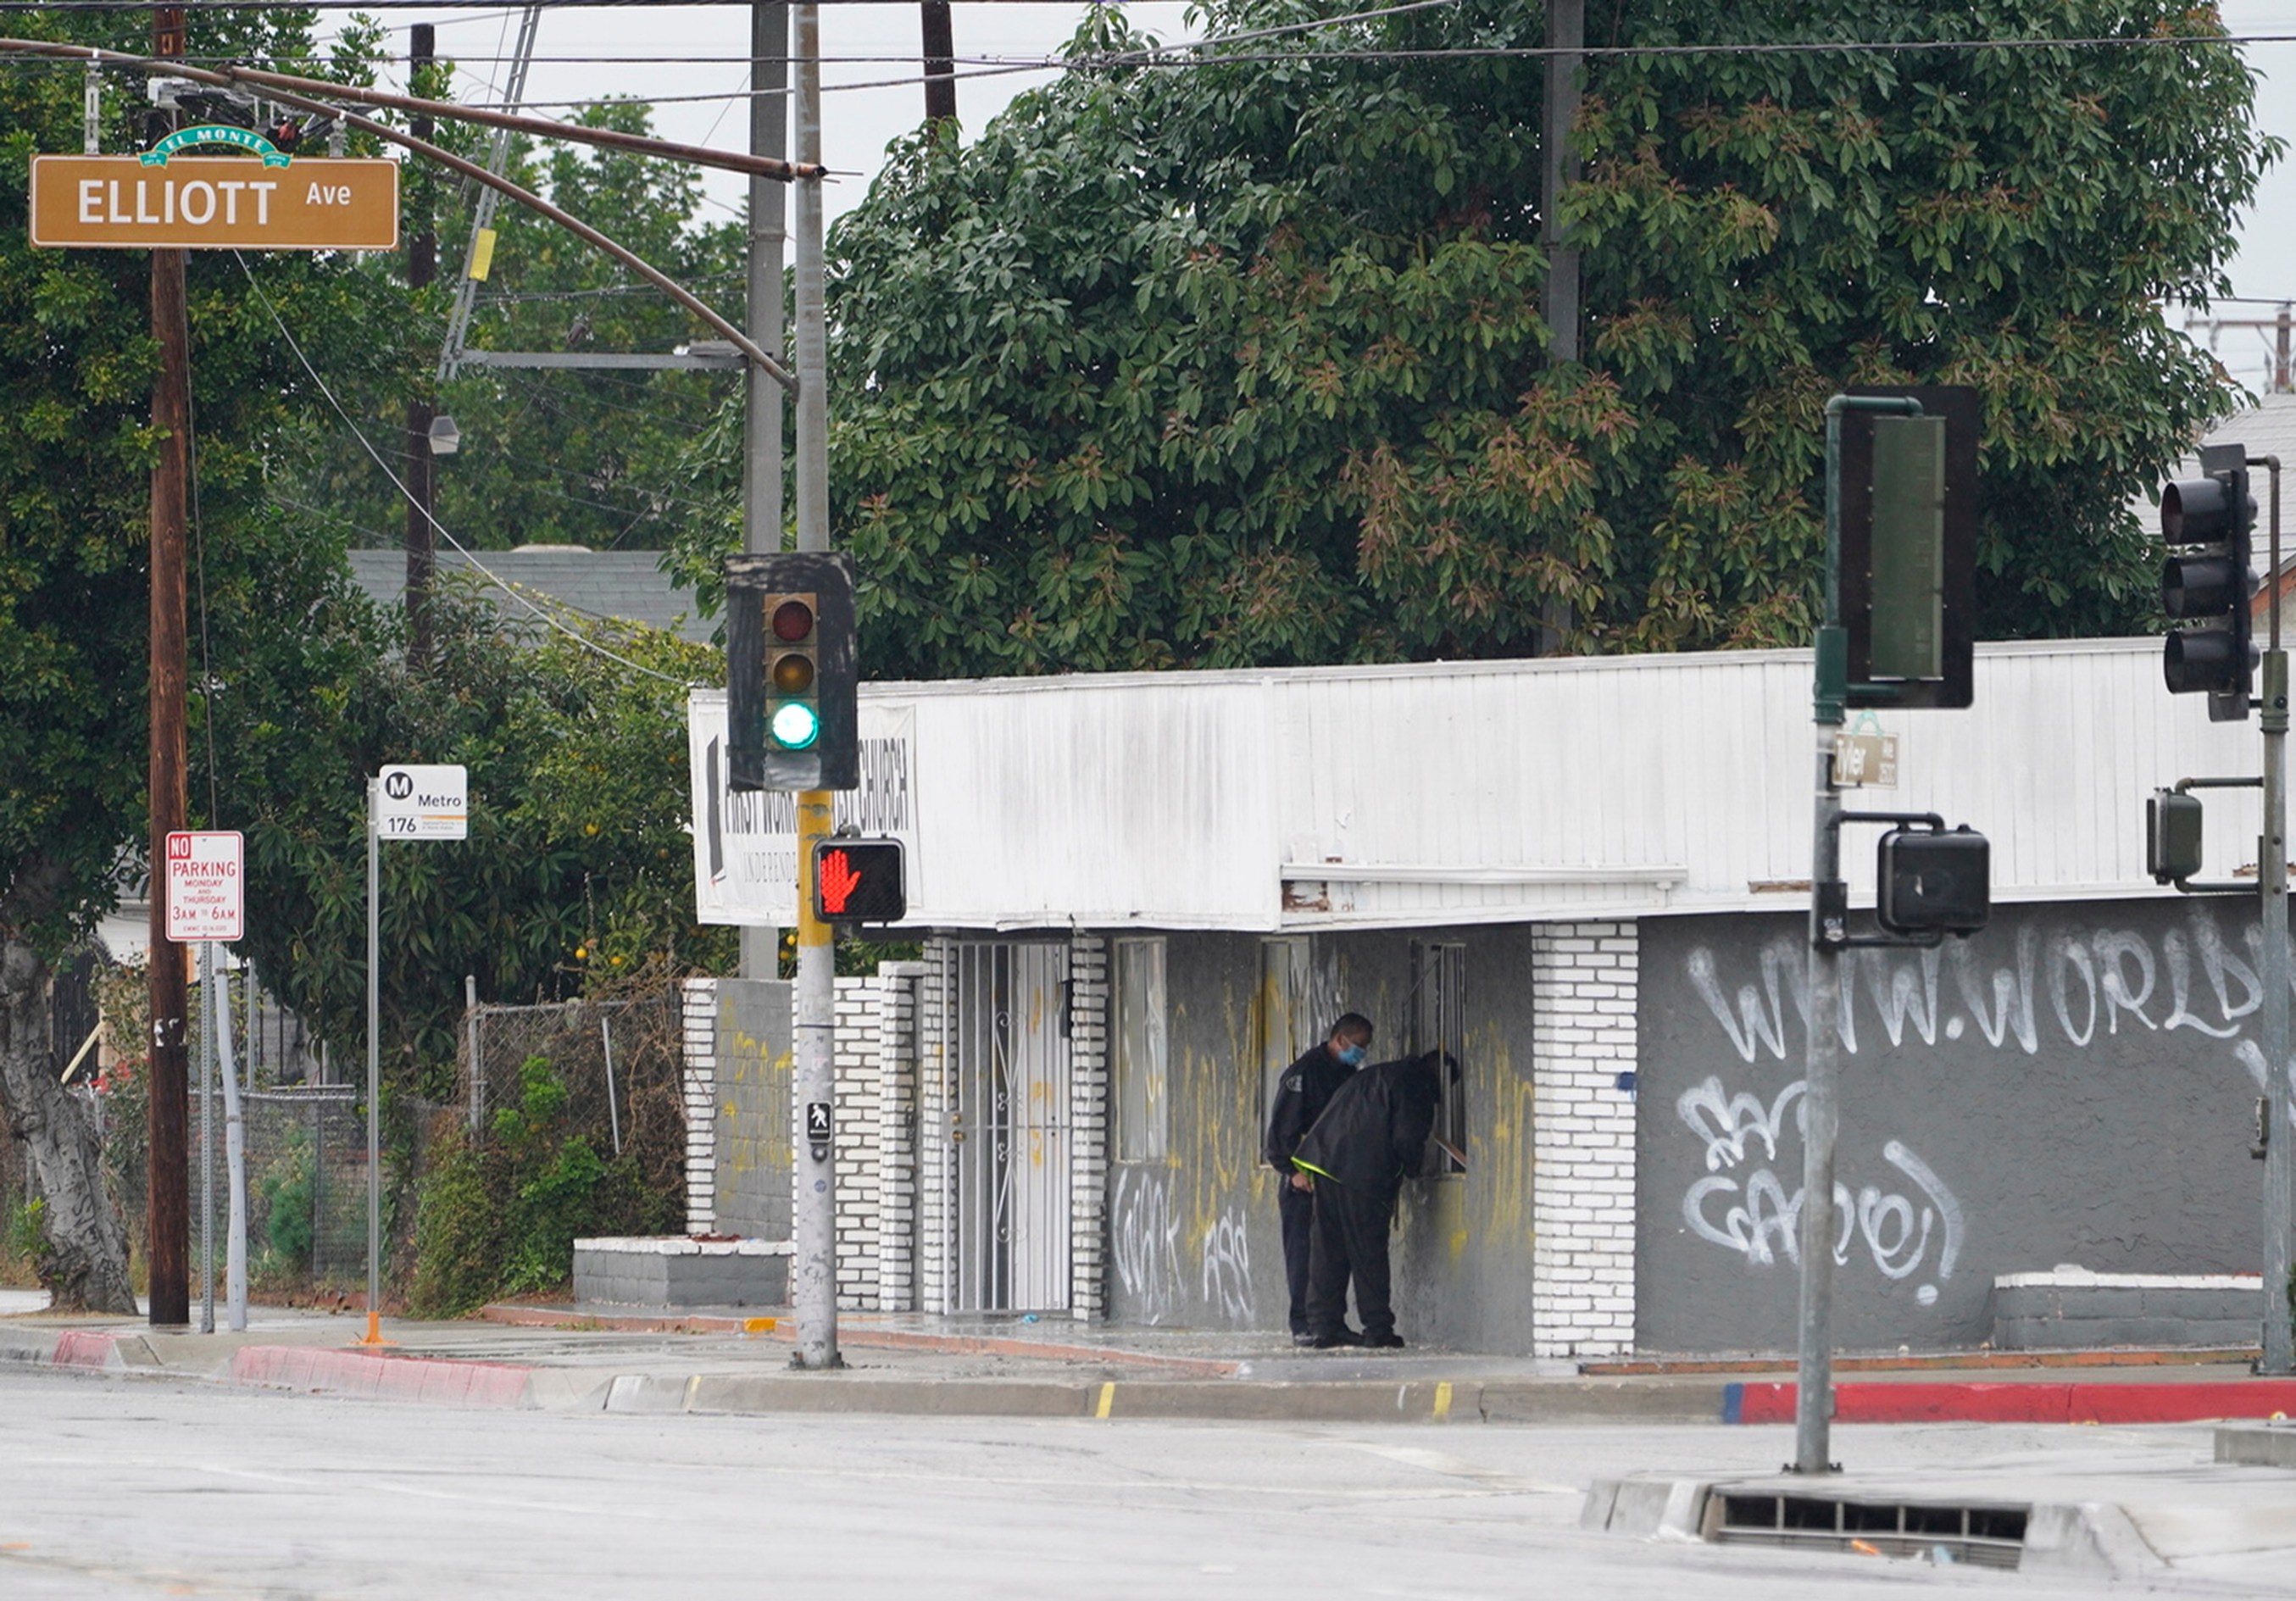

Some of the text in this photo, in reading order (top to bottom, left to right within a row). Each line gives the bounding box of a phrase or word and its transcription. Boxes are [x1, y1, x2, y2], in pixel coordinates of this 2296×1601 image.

[165, 129, 264, 151] EL MONTE
[79, 179, 351, 225] ELLIOTT Ave
[389, 775, 409, 797] M
[418, 794, 462, 808] Metro
[388, 817, 417, 833] 176
[170, 837, 189, 857] NO
[173, 861, 236, 877] PARKING
[742, 851, 799, 883] INDEPENDE
[184, 879, 224, 887] MONDAY
[183, 895, 226, 904] THURSDAY
[173, 905, 197, 920] 3AM
[211, 905, 236, 920] 6AM
